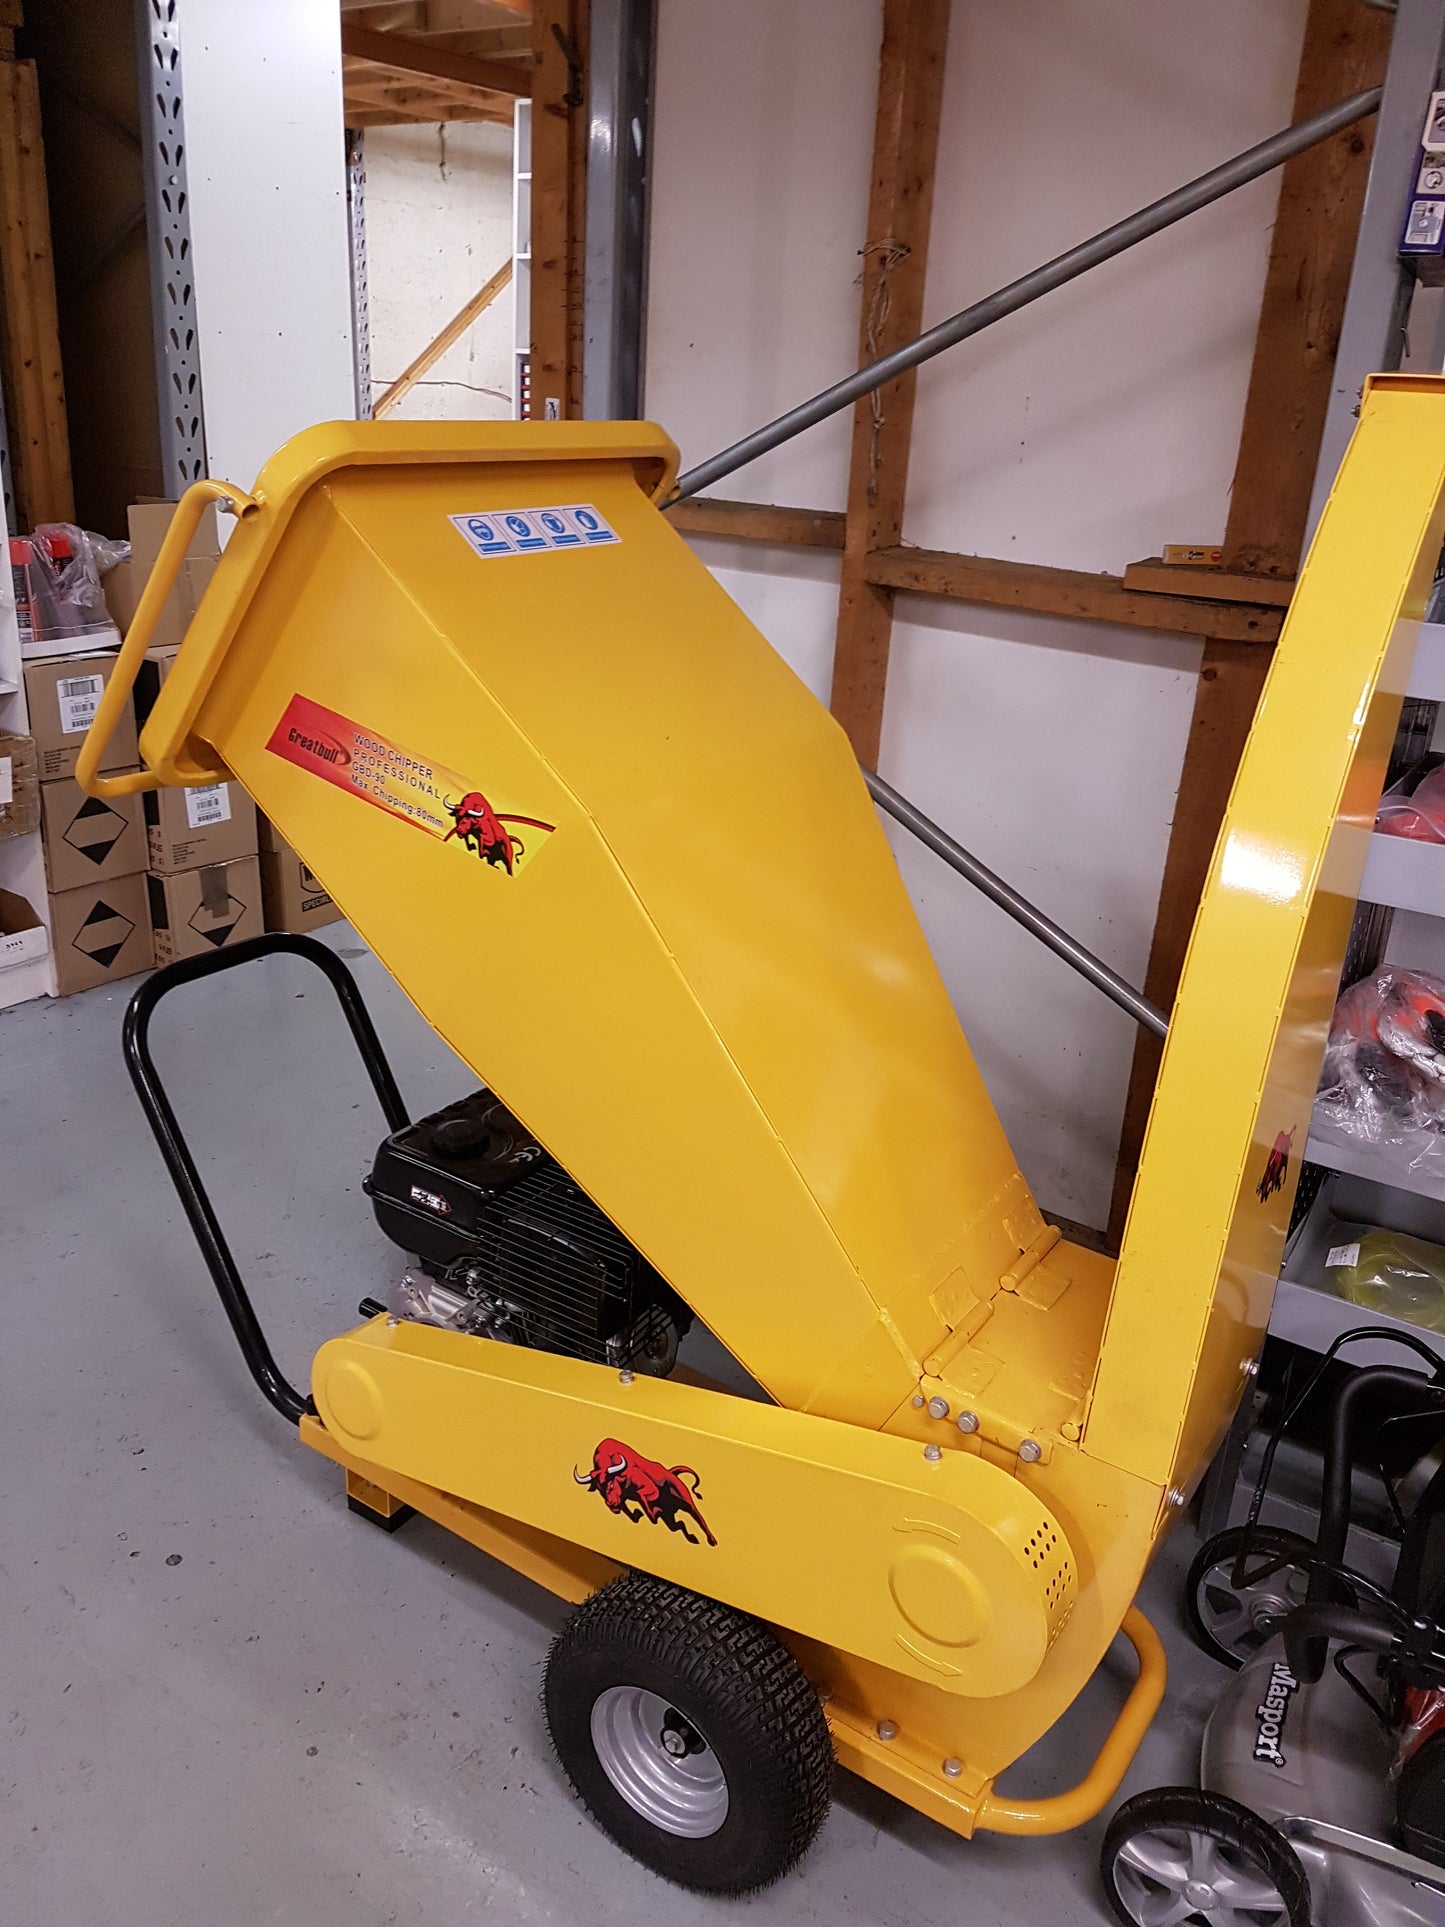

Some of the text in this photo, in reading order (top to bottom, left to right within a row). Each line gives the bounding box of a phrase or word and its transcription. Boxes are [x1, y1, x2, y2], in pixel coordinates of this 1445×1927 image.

[288, 727, 339, 764] Greatbull
[354, 732, 433, 780] WOOD CHIPPER
[352, 761, 386, 785] GBD-90
[353, 748, 441, 800] PROFESSIONAL
